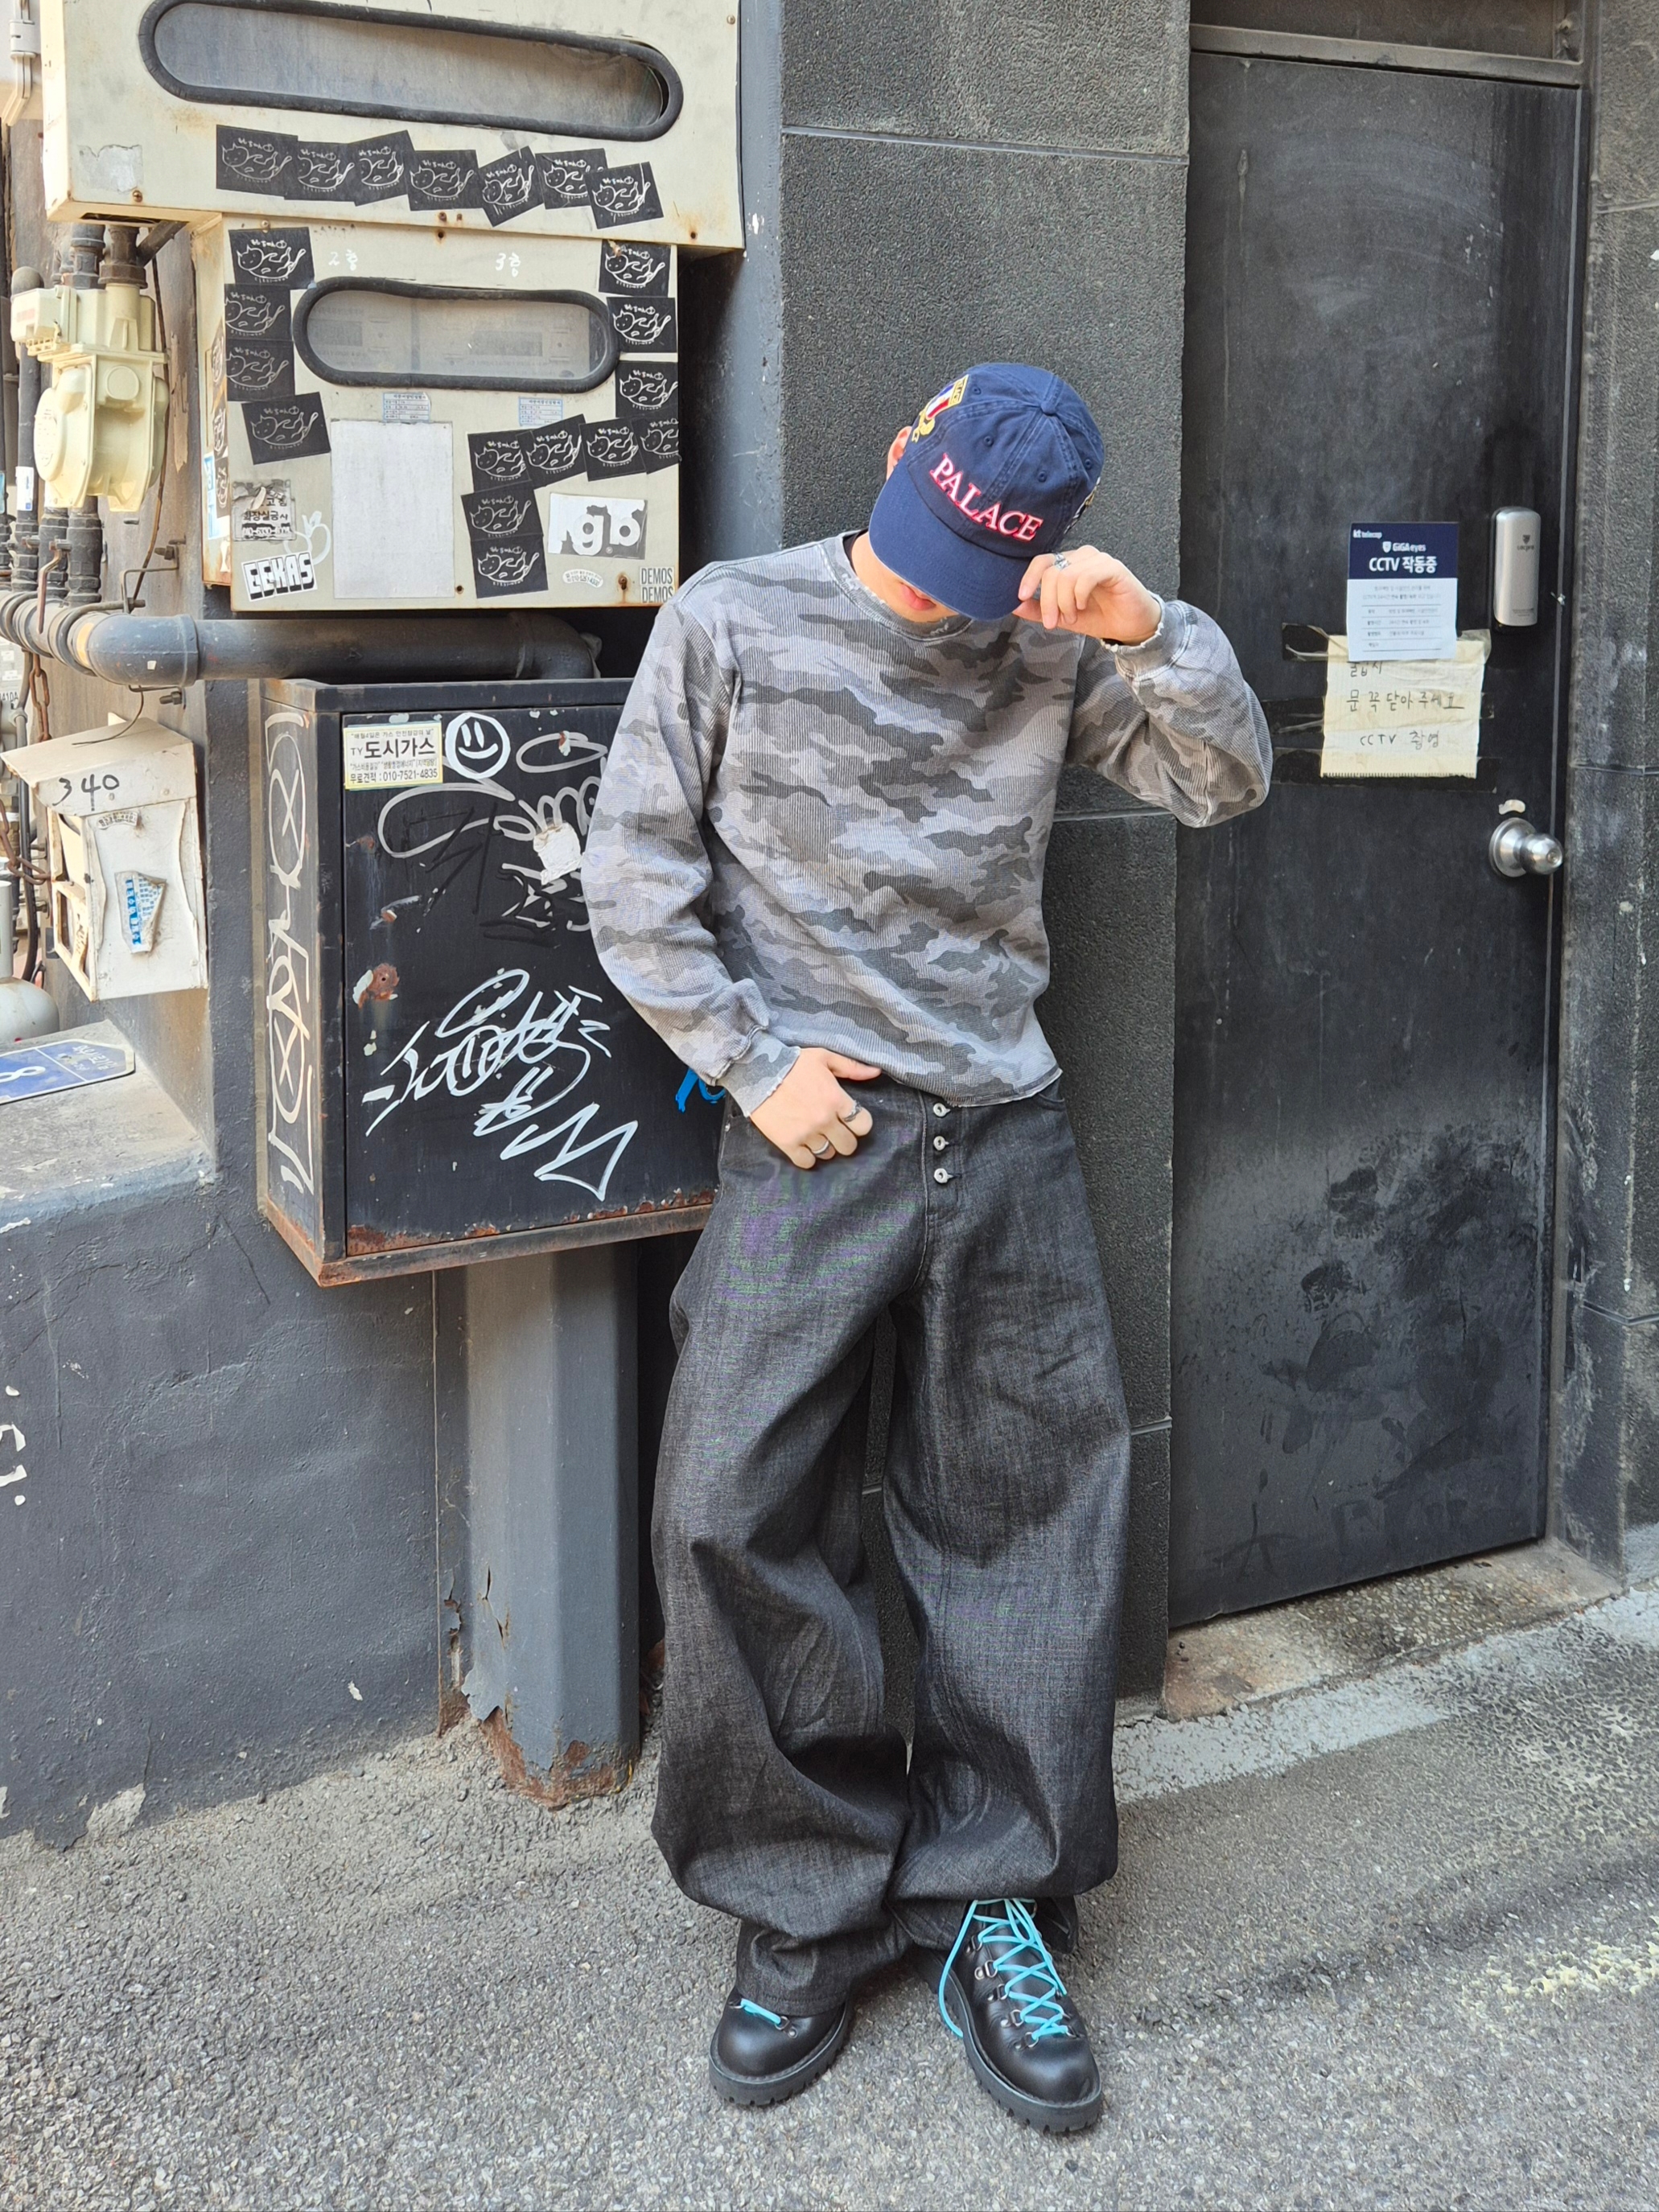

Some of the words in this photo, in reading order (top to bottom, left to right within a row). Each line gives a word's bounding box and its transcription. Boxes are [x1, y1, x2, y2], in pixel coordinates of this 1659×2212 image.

[928, 452, 1044, 542] PALACE
[1369, 557, 1401, 572] CCTV
[1402, 555, 1438, 574] 작동중
[641, 567, 673, 585] DEMOS
[642, 586, 673, 603] DEMOS
[1346, 689, 1360, 713] 문
[1369, 691, 1381, 713] 꼭
[382, 730, 393, 738] 가스
[1360, 733, 1398, 746] CCTV
[350, 747, 364, 756] TY
[364, 738, 436, 759] 도시가스
[350, 771, 377, 784] 무료견적
[51, 774, 120, 812] 340
